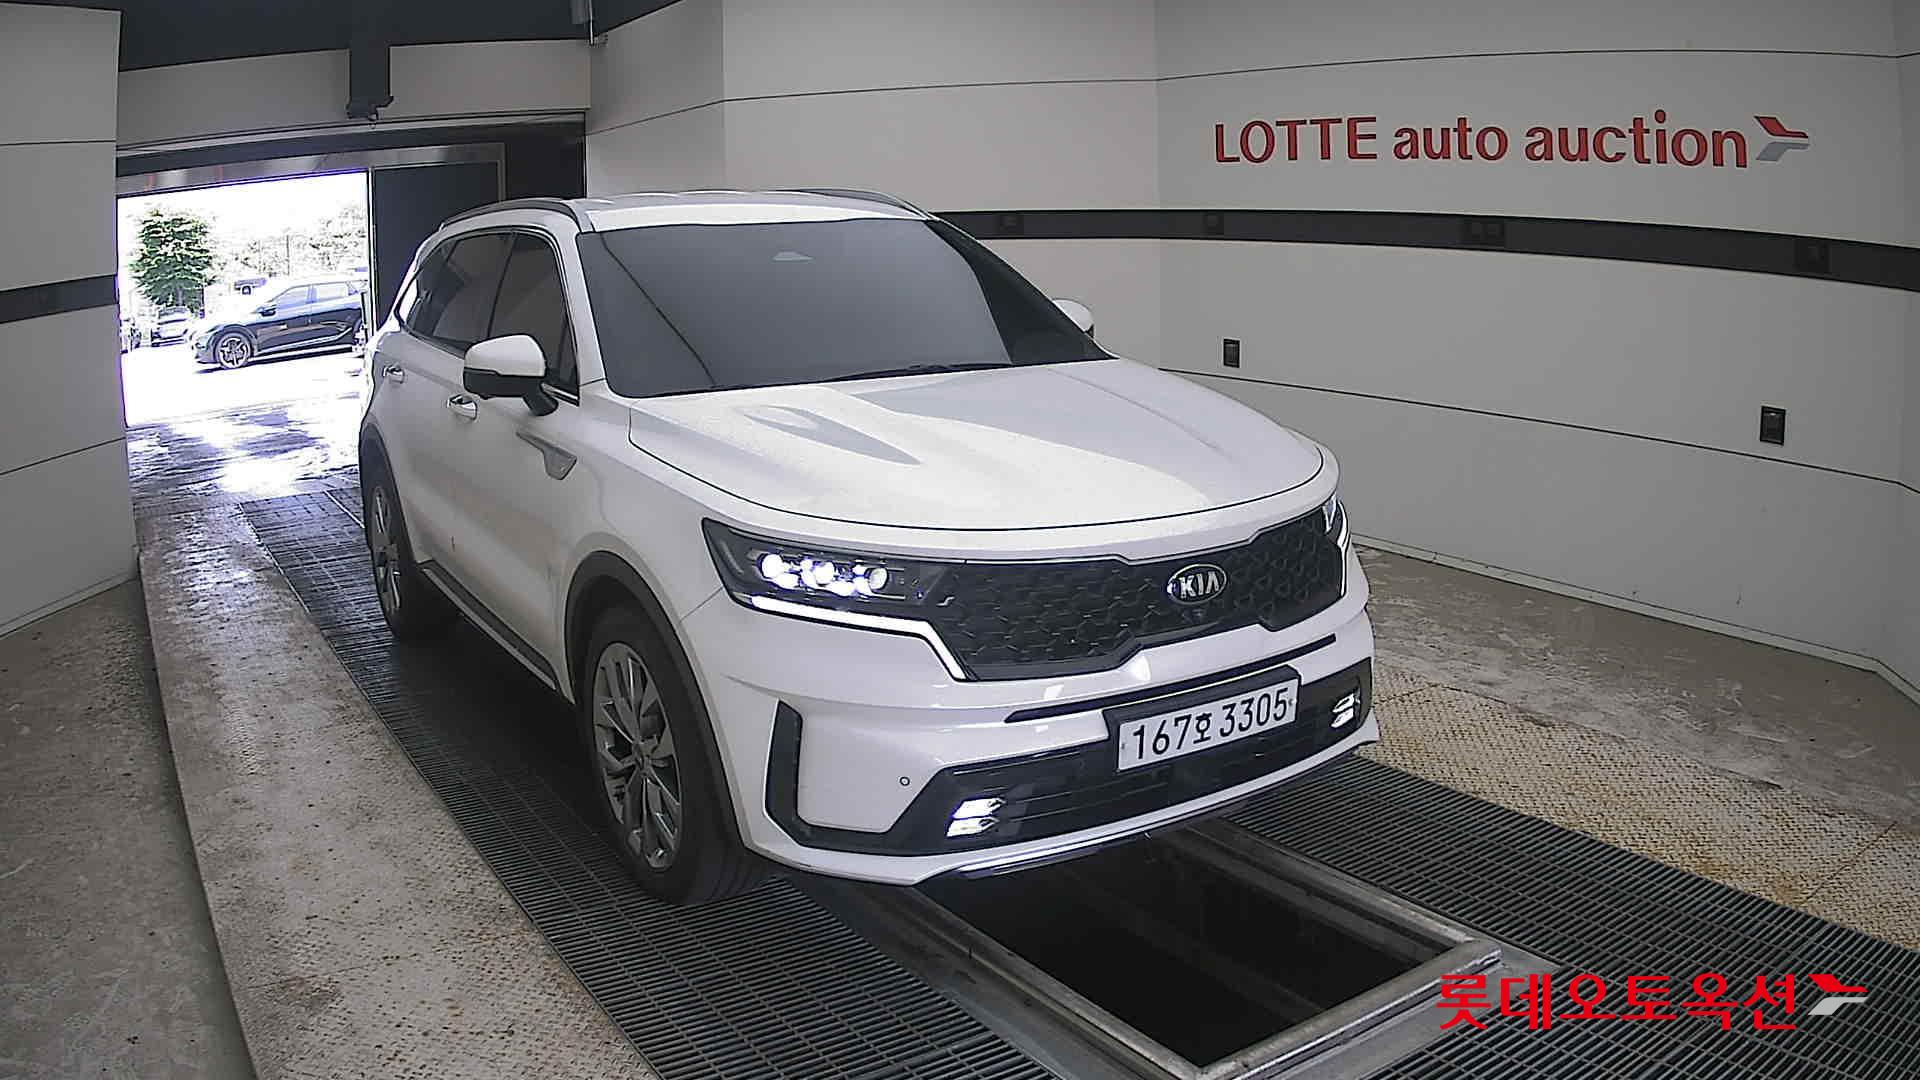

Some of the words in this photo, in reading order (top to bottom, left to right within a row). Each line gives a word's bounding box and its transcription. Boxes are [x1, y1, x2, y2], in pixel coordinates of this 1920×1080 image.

[1214, 116, 1378, 164] LOTTE
[1393, 117, 1509, 161] auto
[1524, 109, 1748, 168] auction
[1178, 571, 1220, 599] KIA
[1133, 713, 1212, 760] 167호
[1219, 687, 1289, 738] 3305
